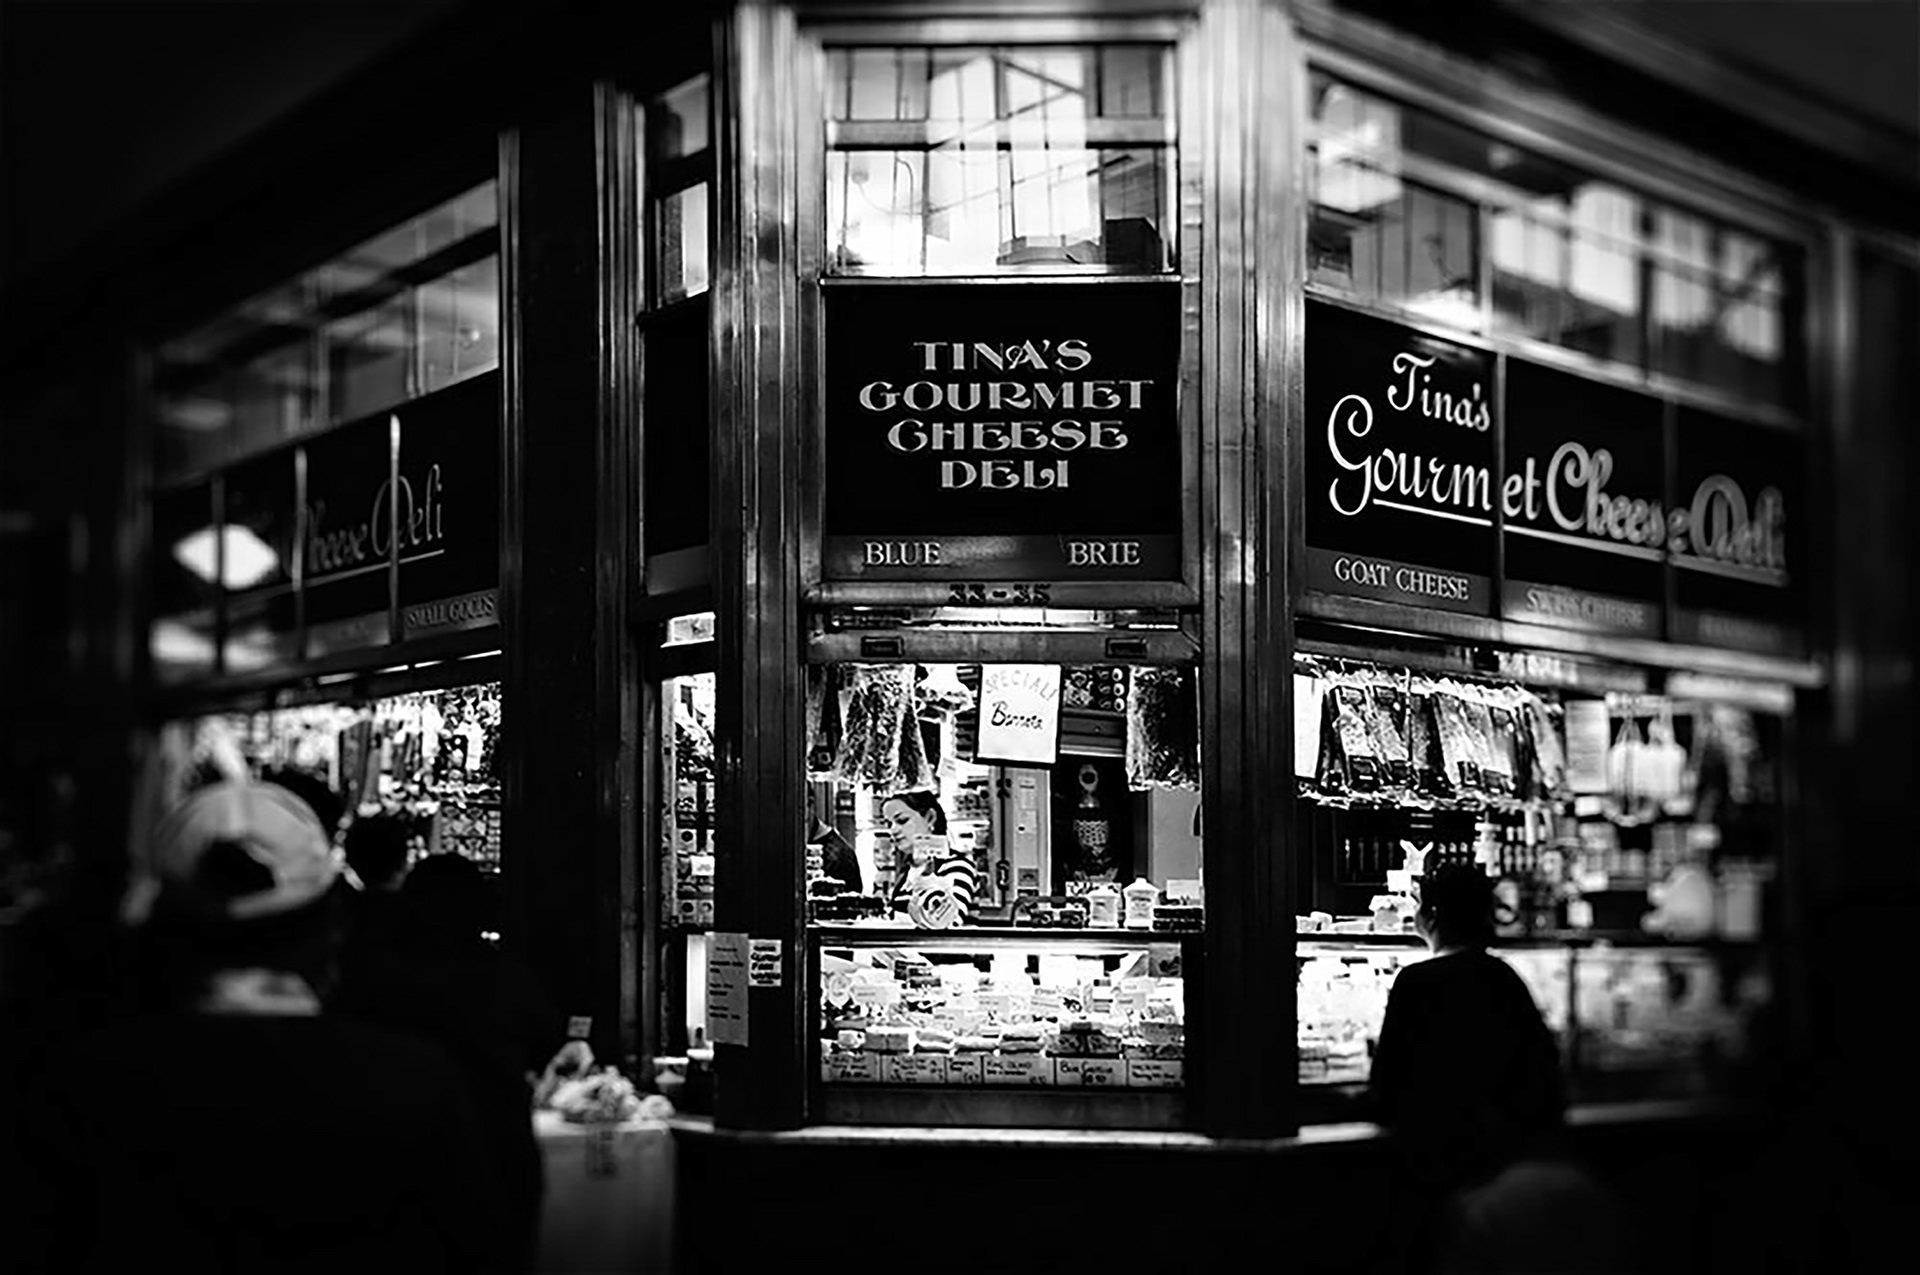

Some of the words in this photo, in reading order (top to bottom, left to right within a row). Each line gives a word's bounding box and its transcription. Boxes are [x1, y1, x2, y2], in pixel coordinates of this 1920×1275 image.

[913, 339, 1092, 371] TINA'S
[859, 380, 1155, 412] GOURMET
[1386, 352, 1491, 432] Tina's
[887, 418, 1129, 452] CHEESE
[940, 459, 1069, 490] DELI
[371, 463, 443, 557] Deli
[1546, 441, 1691, 555] Cheese
[865, 542, 941, 565] BLUE
[1069, 542, 1140, 566] BRIE
[1334, 556, 1391, 587] GOAT
[1395, 567, 1470, 601] CHEESE
